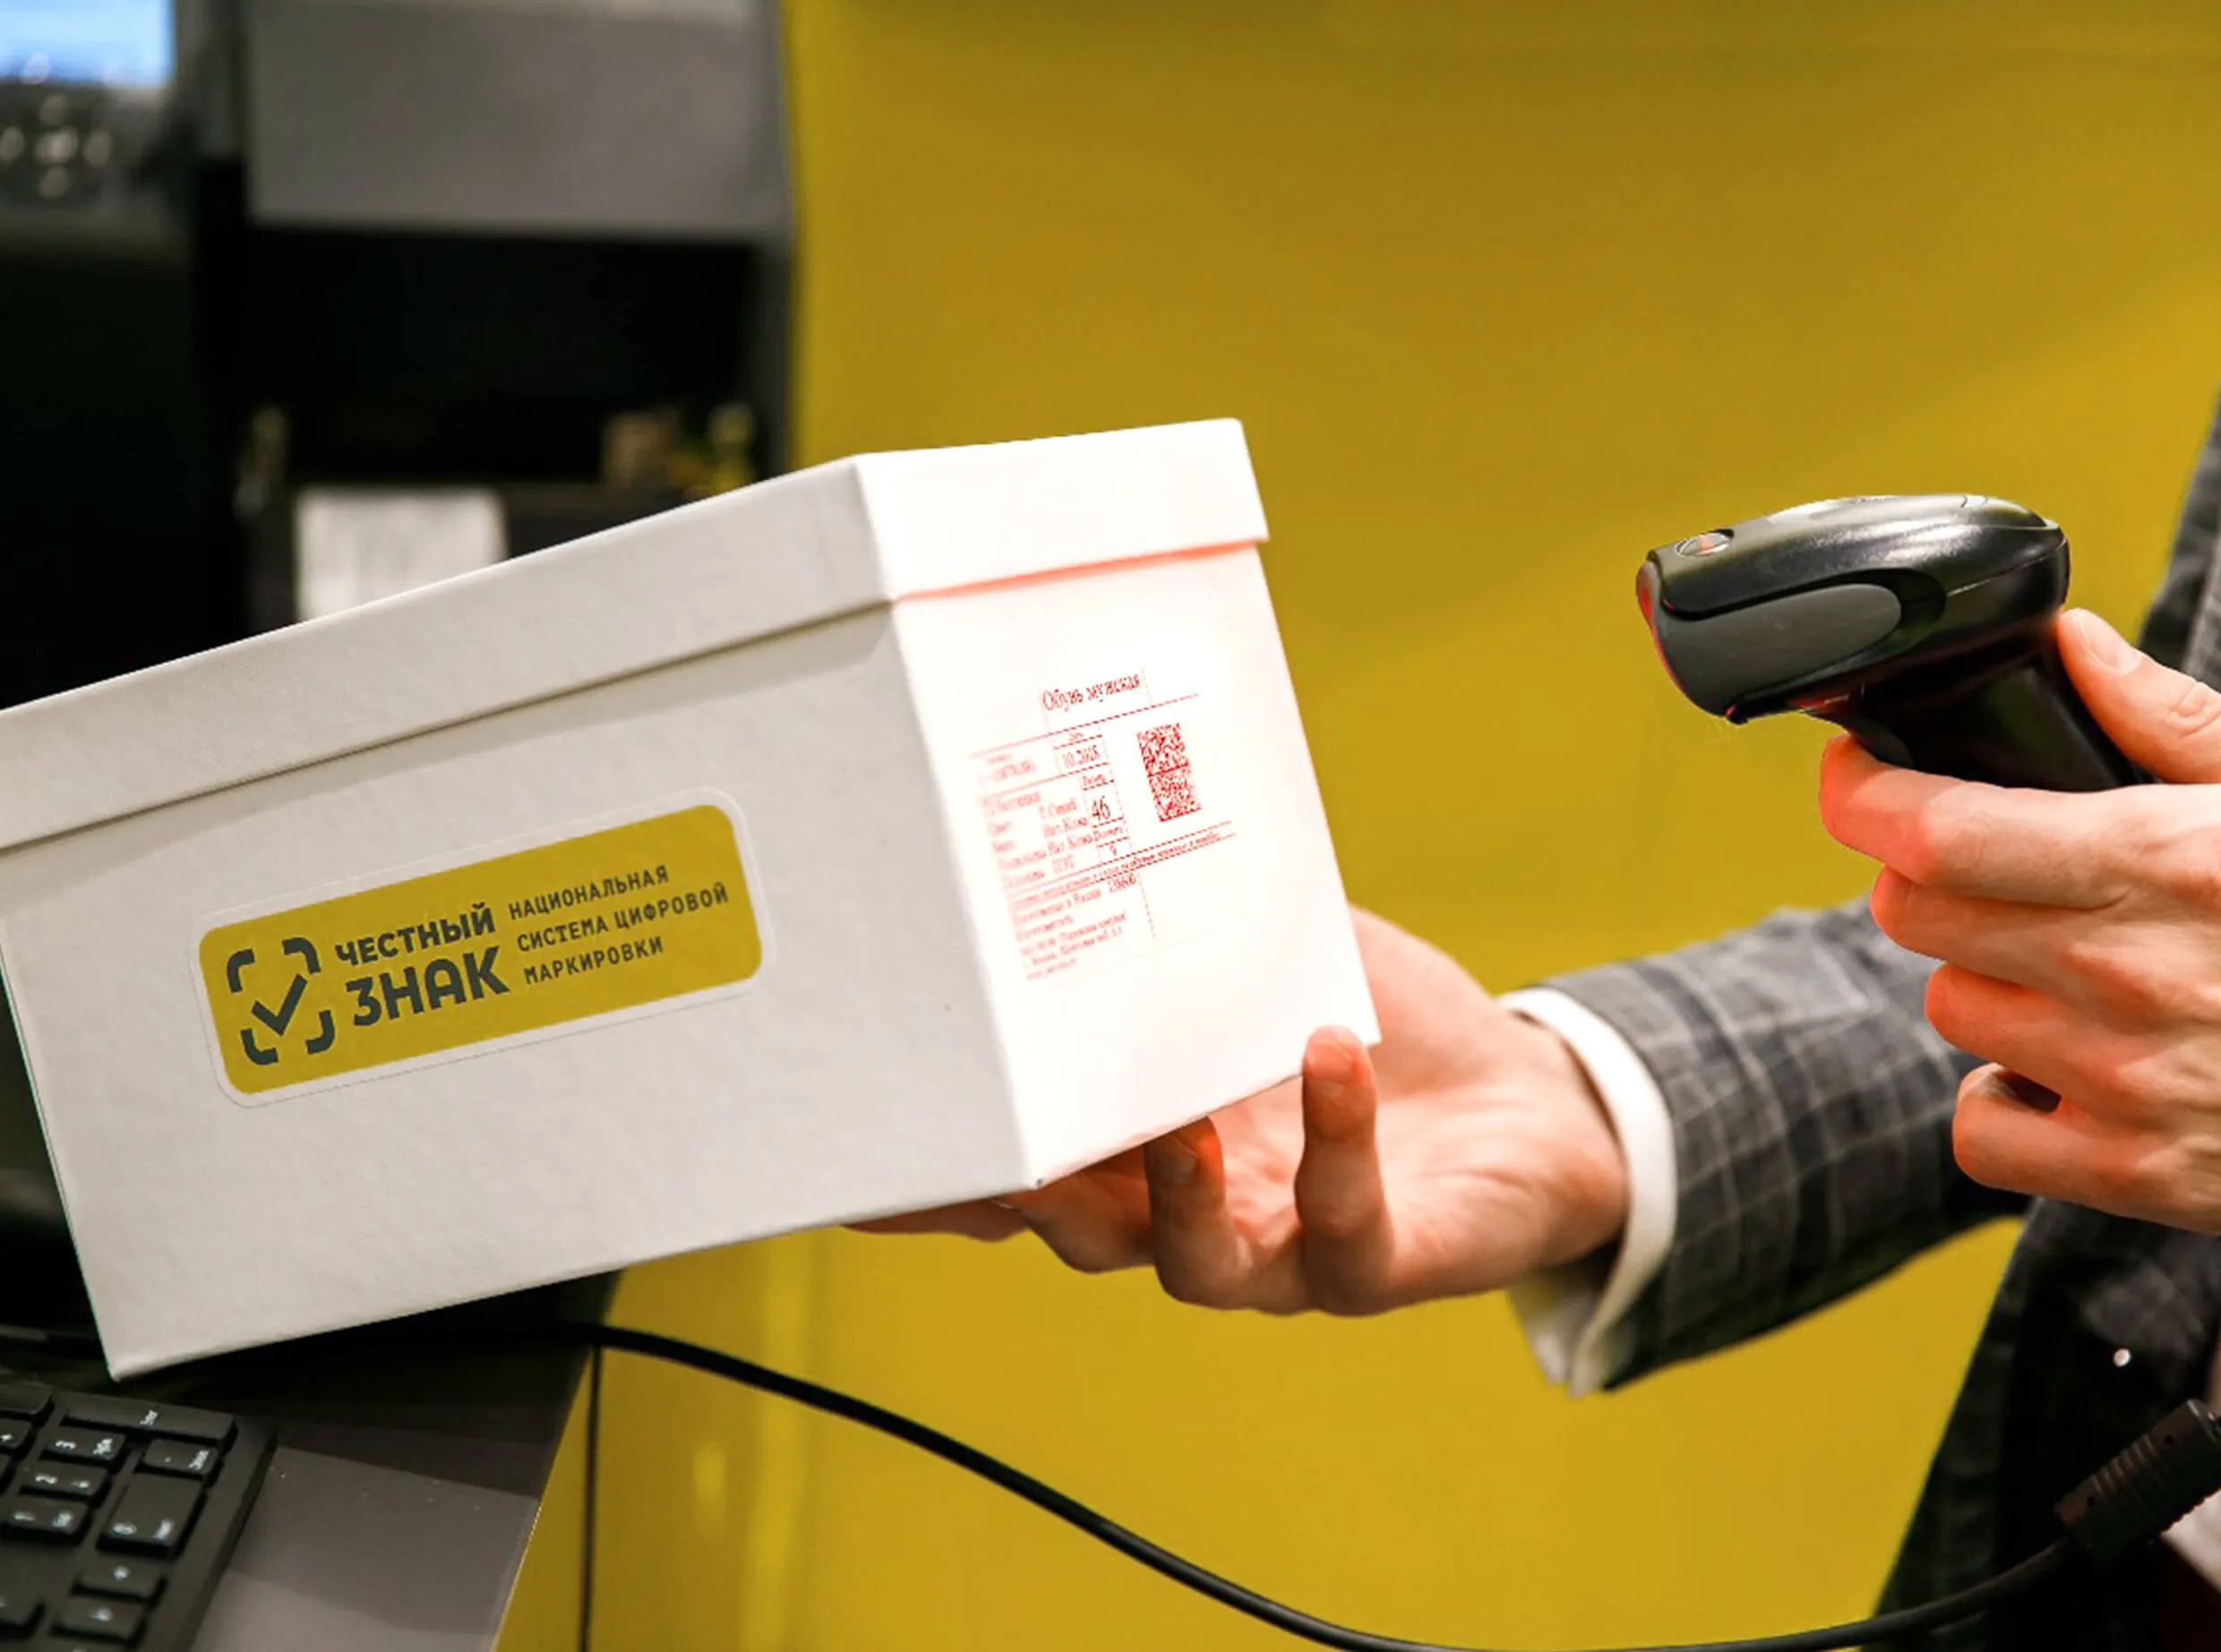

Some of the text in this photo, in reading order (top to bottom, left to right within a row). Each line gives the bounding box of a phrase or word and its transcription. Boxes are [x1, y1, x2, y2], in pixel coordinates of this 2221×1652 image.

[1042, 673, 1139, 712] Обувь мужская
[1092, 795, 1111, 821] 46
[508, 864, 669, 920] НАЦИОНАЛЬНАЯ
[517, 881, 728, 953] СИСТЕМА ЦИФРОВОЙ
[335, 901, 496, 966] ЧЕСТНЫЙ
[524, 936, 664, 985] МАРКИРОВКИ
[345, 945, 510, 1027] ЗНАК
